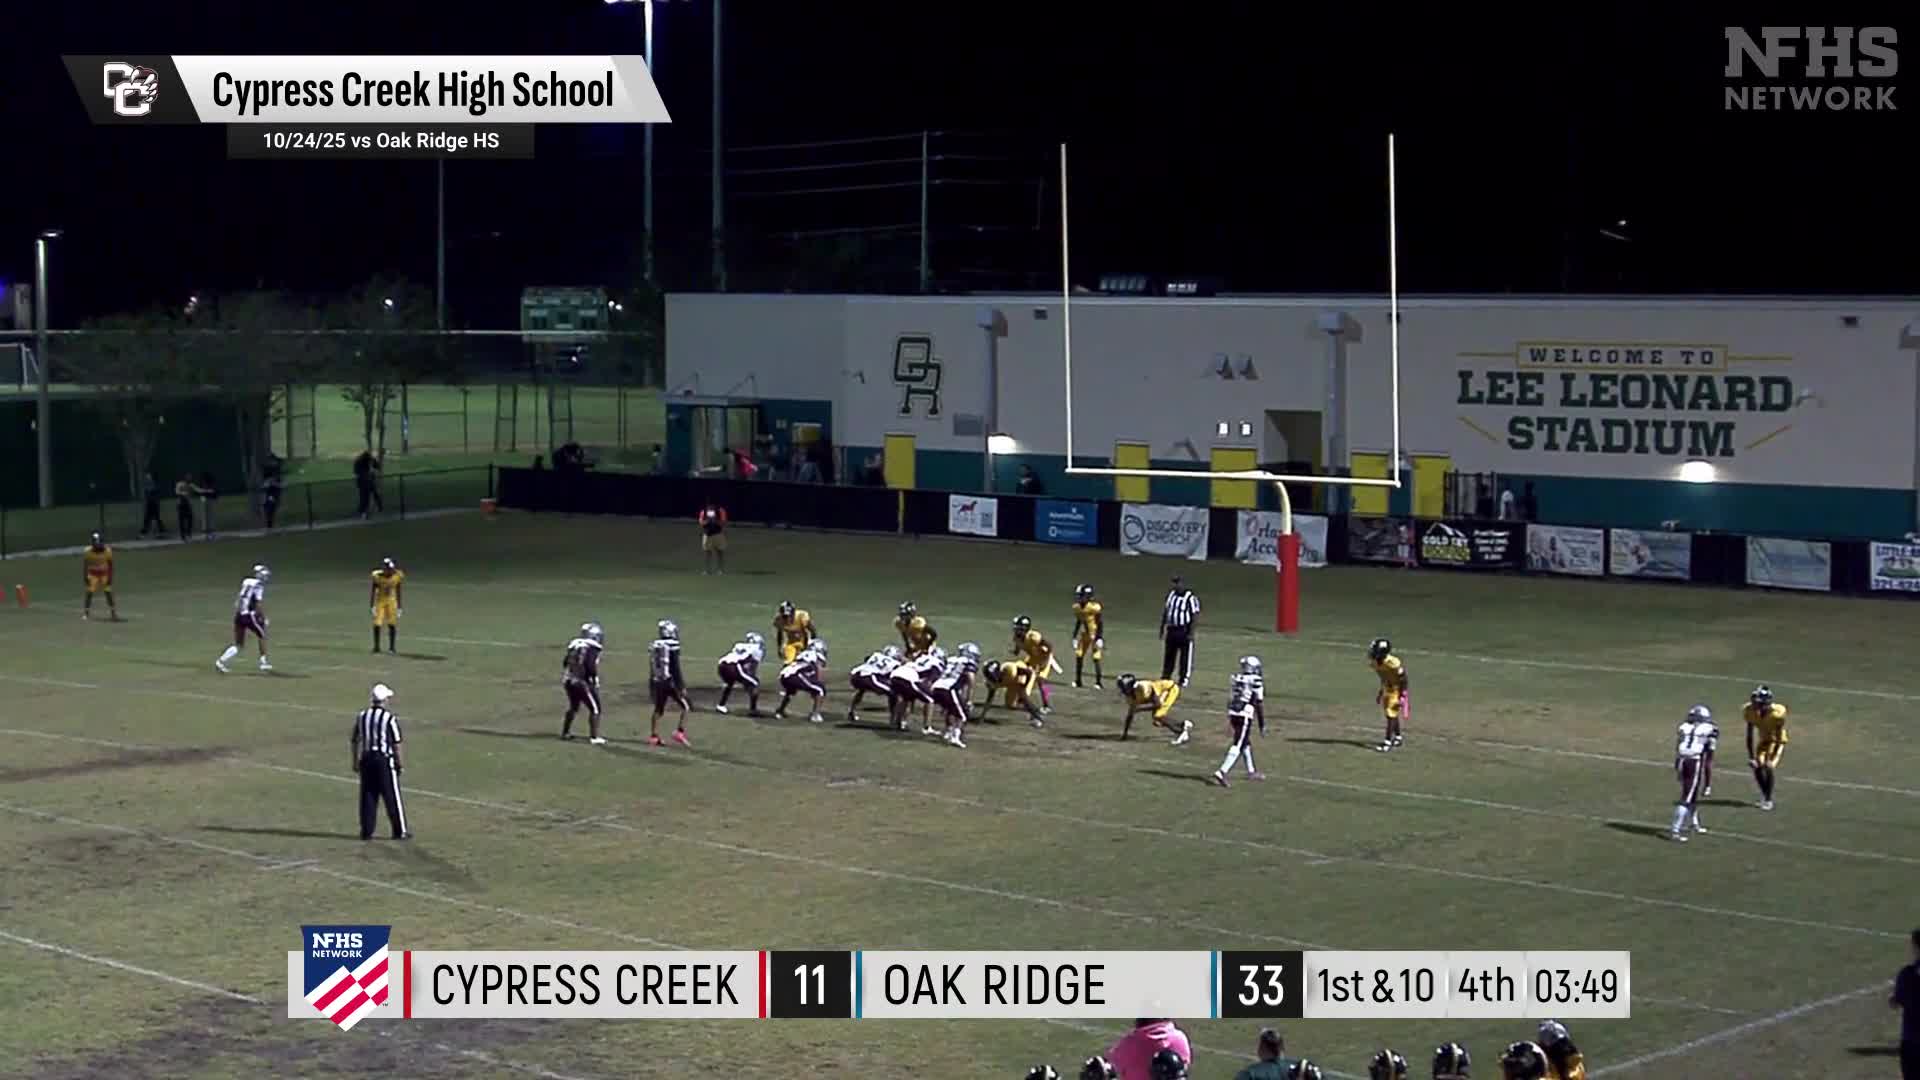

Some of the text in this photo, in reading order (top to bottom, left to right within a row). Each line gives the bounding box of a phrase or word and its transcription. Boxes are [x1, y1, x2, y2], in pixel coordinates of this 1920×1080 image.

[1529, 347, 1715, 365] WELCOME TO
[1457, 370, 1794, 412] LEE LEONARD
[1507, 415, 1737, 457] STADIUM
